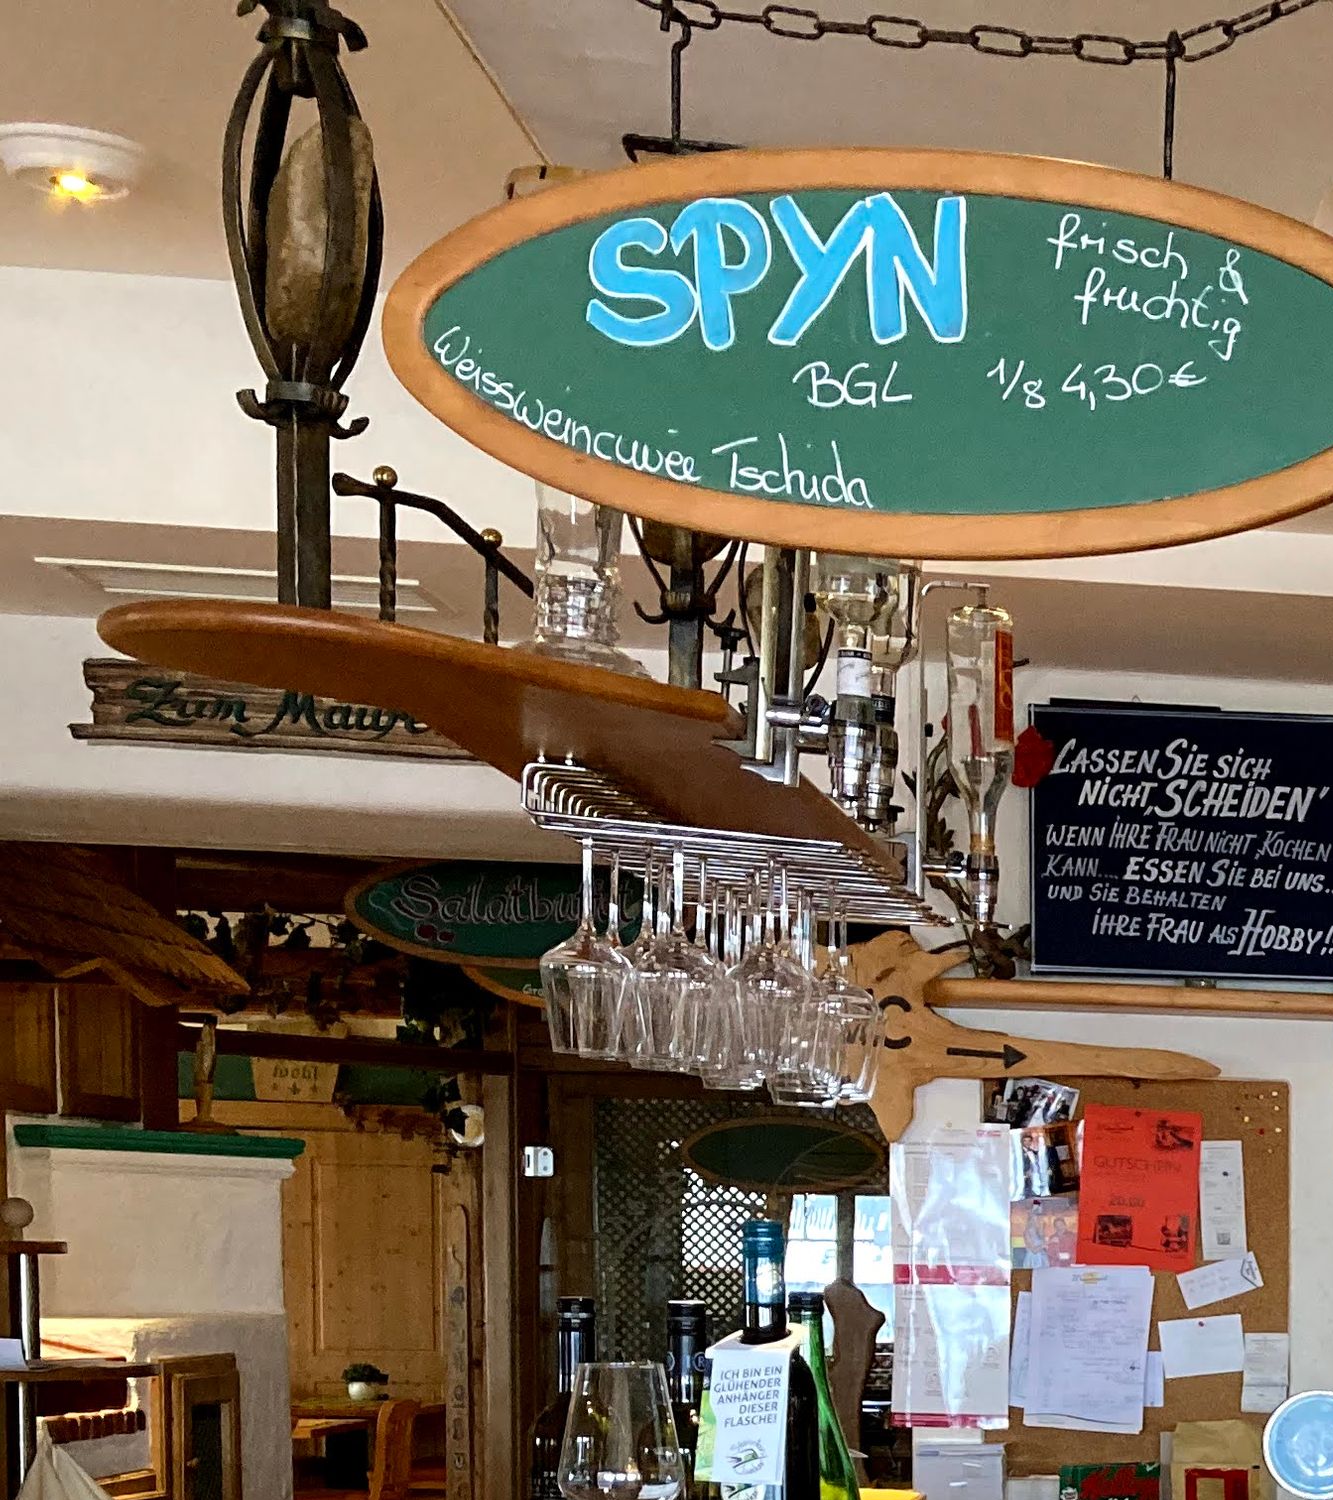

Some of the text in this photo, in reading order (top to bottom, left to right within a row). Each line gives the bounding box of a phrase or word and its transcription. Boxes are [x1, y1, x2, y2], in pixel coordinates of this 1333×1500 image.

[586, 192, 968, 351] SPYN
[1047, 213, 1249, 304] frisch &
[1075, 267, 1242, 360] fruchtig
[793, 358, 1207, 410] BGL 1/8 4,30€
[125, 677, 430, 740] Zum Maur
[1049, 739, 1158, 776] LASSEN
[1046, 824, 1106, 846] WENN
[1155, 822, 1204, 852] FRAU
[1123, 857, 1205, 884] ESSEN
[1048, 885, 1083, 901] UND
[1124, 887, 1227, 912] BEHALTEN
[1147, 912, 1204, 944] FRAU
[713, 1378, 781, 1393] GLÜHENDER
[720, 1365, 783, 1380] ICH BIN EIN
[717, 1389, 780, 1405] ANHÄNGER
[739, 1401, 778, 1415] DIESER
